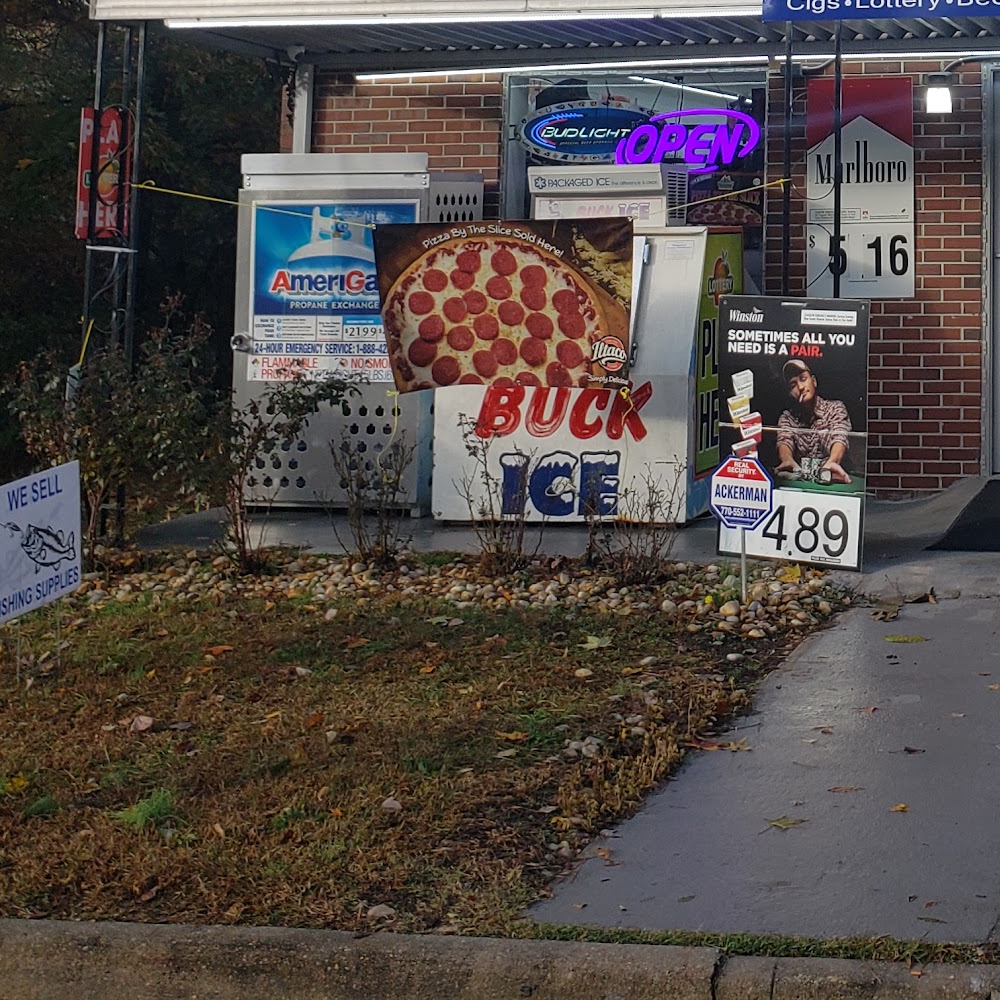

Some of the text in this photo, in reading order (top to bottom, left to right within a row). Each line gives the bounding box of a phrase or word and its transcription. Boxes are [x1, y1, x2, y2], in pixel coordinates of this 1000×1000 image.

[625, 123, 745, 164] OPEN
[815, 140, 907, 184] Mrlboro
[548, 178, 593, 187] PACKAGED
[596, 177, 610, 186] ICE
[618, 203, 650, 220] ICE
[422, 224, 565, 257] Pizza By The Slice Sold Here!
[867, 234, 909, 277] 16
[271, 269, 379, 294] AmeriGa
[709, 279, 733, 293] LOTTERY
[290, 300, 380, 310] PROPANE EXCHANGE
[729, 309, 764, 323] Winston
[728, 329, 855, 346] SOMETIMES ALL YOU
[254, 343, 283, 354] 24-HOUR
[286, 343, 324, 354] EMERGENCY
[728, 342, 823, 357] NEED IS A PAIR.
[351, 358, 364, 368] NO
[475, 381, 653, 442] BUCK
[7, 474, 63, 511] WE SELL
[499, 450, 621, 517] ICE
[715, 483, 767, 502] ACKERMAN
[721, 506, 760, 518] 770-552-1111
[36, 566, 79, 600] SUPPLIES
